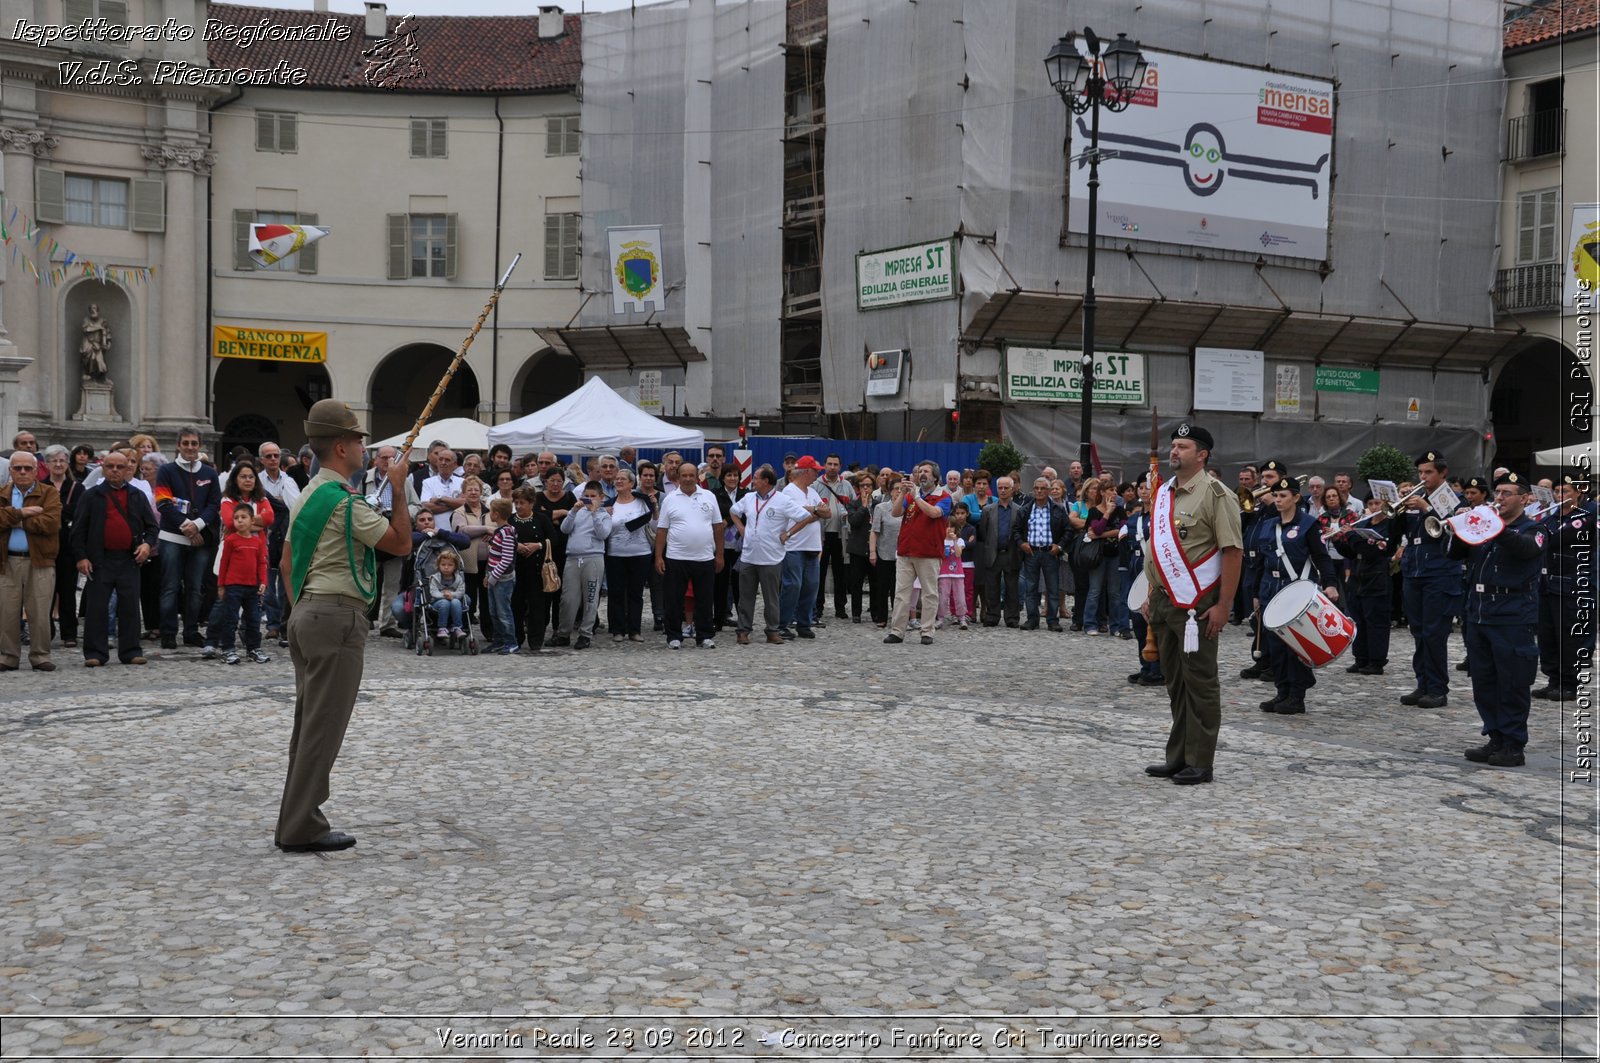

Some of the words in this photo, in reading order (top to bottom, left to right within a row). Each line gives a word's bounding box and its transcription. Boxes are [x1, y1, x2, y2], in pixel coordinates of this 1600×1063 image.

[1265, 88, 1330, 116] mensa
[884, 256, 922, 277] IMPRESA
[926, 245, 945, 271] ST
[861, 282, 898, 296] EDILIZIA
[900, 273, 950, 291] GENERALE
[237, 330, 285, 343] BANCO
[290, 333, 304, 344] DI
[217, 340, 322, 360] BENEFICENZA
[1106, 355, 1130, 377] ST
[1316, 369, 1338, 378] UNITED
[1338, 370, 1362, 380] COLORS
[1010, 374, 1067, 389] EDILIZIA
[1315, 377, 1324, 386] OF
[1161, 542, 1182, 578] CARITAS
